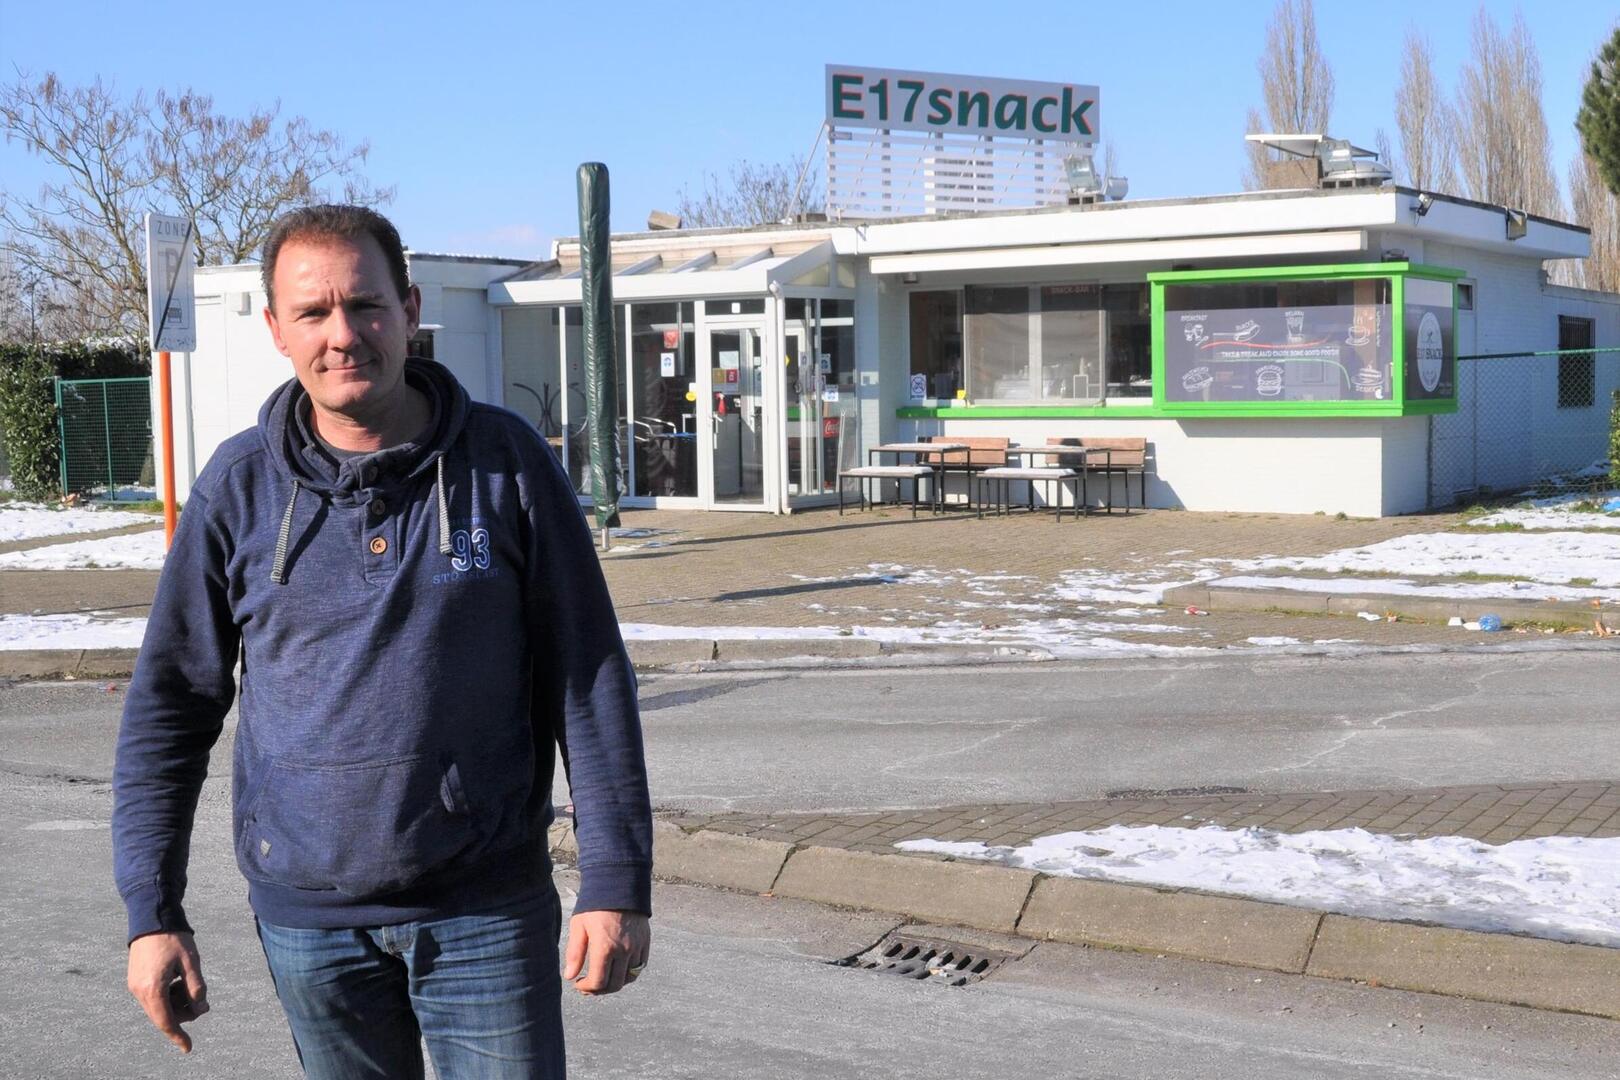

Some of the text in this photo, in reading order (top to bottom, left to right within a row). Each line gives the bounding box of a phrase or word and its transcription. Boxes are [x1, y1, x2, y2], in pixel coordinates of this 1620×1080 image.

[832, 74, 1094, 135] E17snack
[157, 221, 187, 237] ZONE
[451, 528, 491, 571] 93
